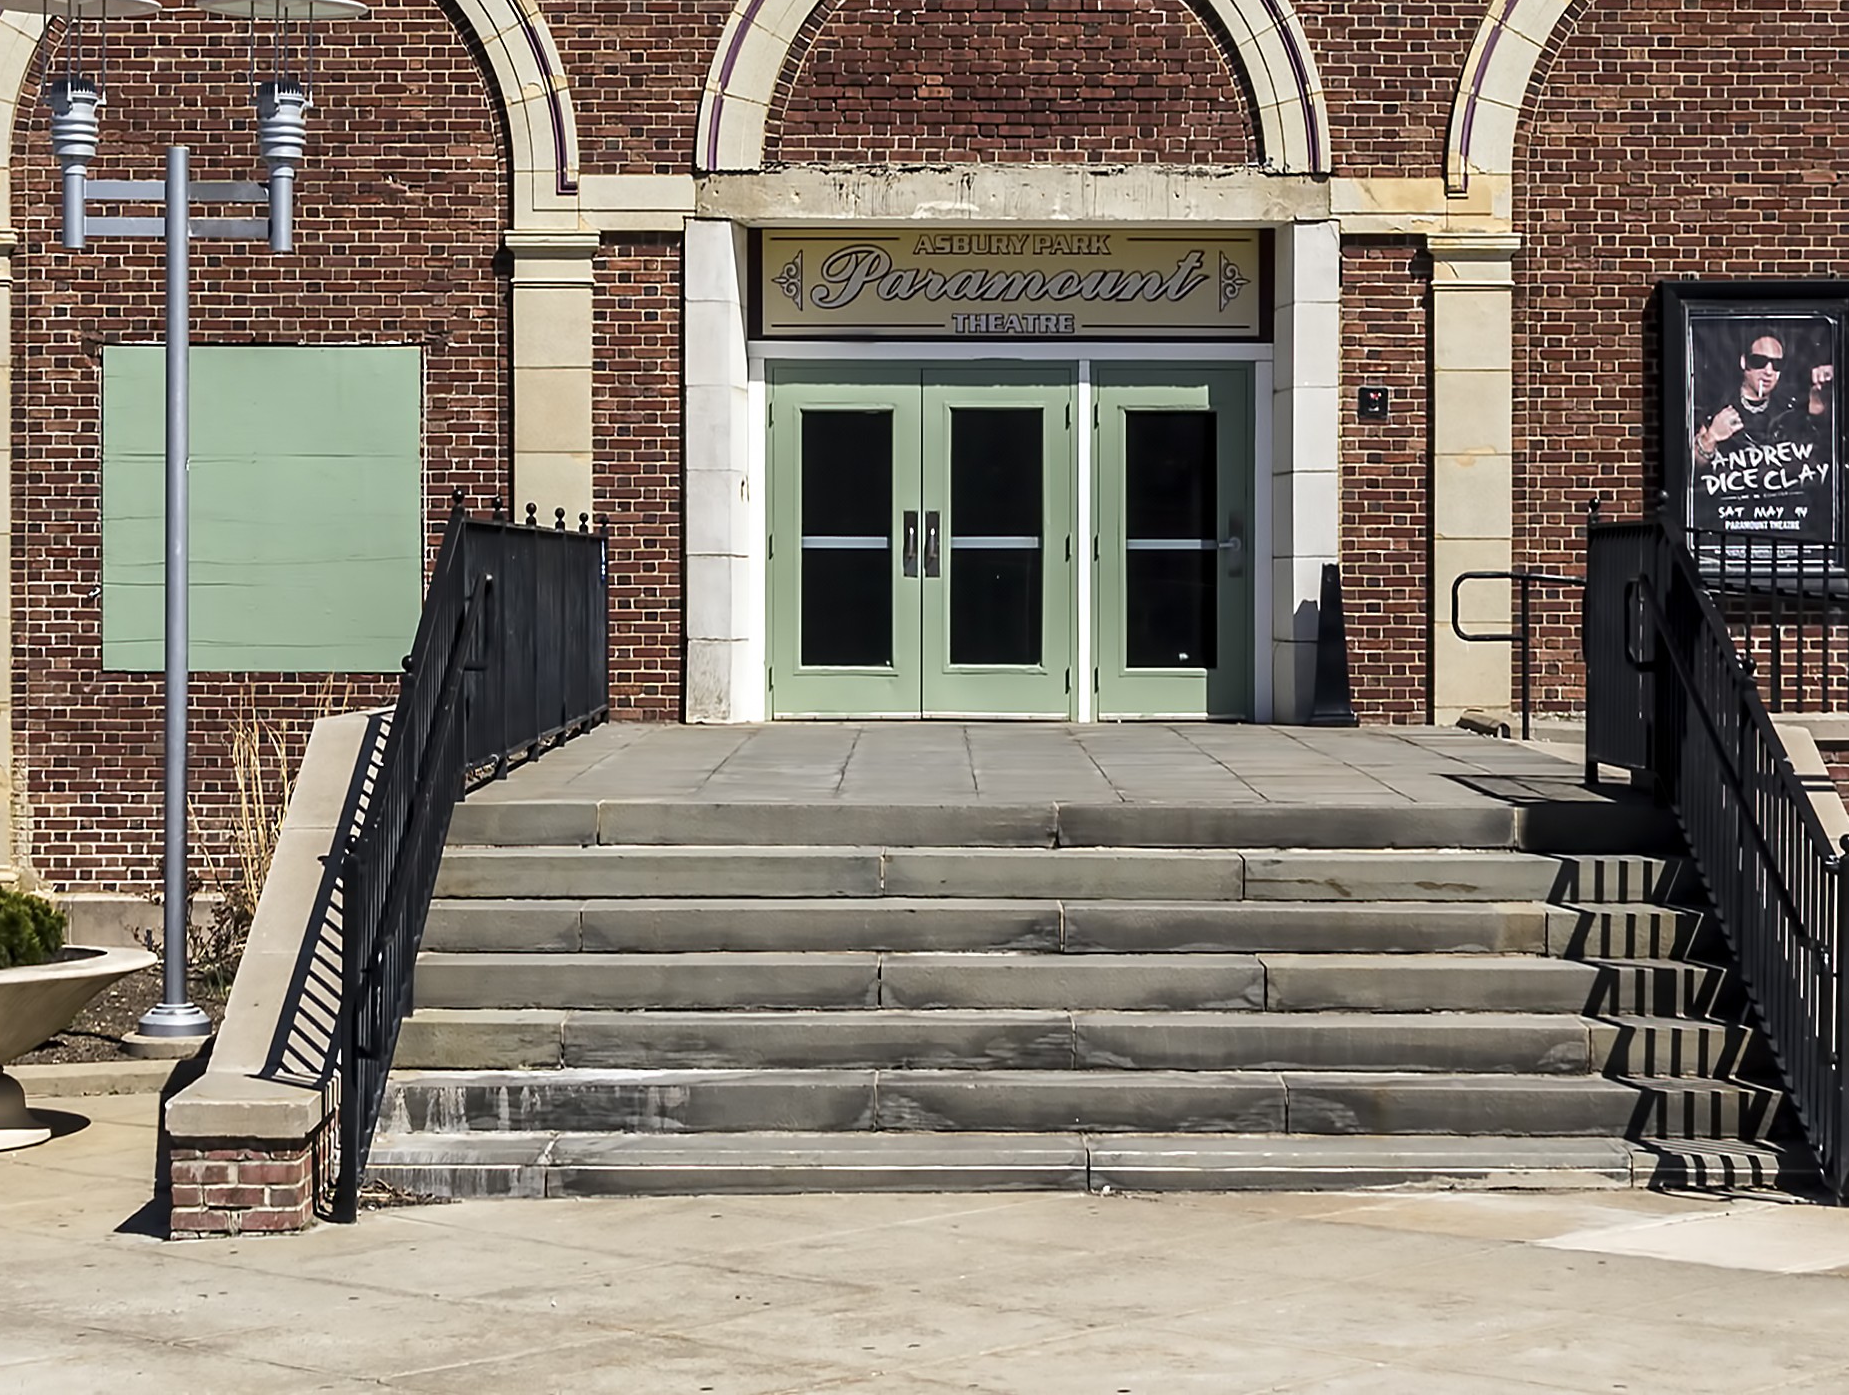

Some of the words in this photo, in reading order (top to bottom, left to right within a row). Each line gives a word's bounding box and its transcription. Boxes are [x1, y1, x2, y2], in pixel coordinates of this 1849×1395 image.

[912, 234, 1032, 255] ASBURY
[1033, 234, 1112, 255] PARK
[809, 244, 1212, 310] Paramount
[951, 312, 1075, 334] THEATRE
[1711, 442, 1813, 471] ANDREW
[1701, 468, 1758, 495] DICE
[1763, 463, 1829, 490] CLAY
[1718, 506, 1745, 518] SAT
[1753, 506, 1784, 518] MAY
[1724, 520, 1768, 530] PARAMOUNT
